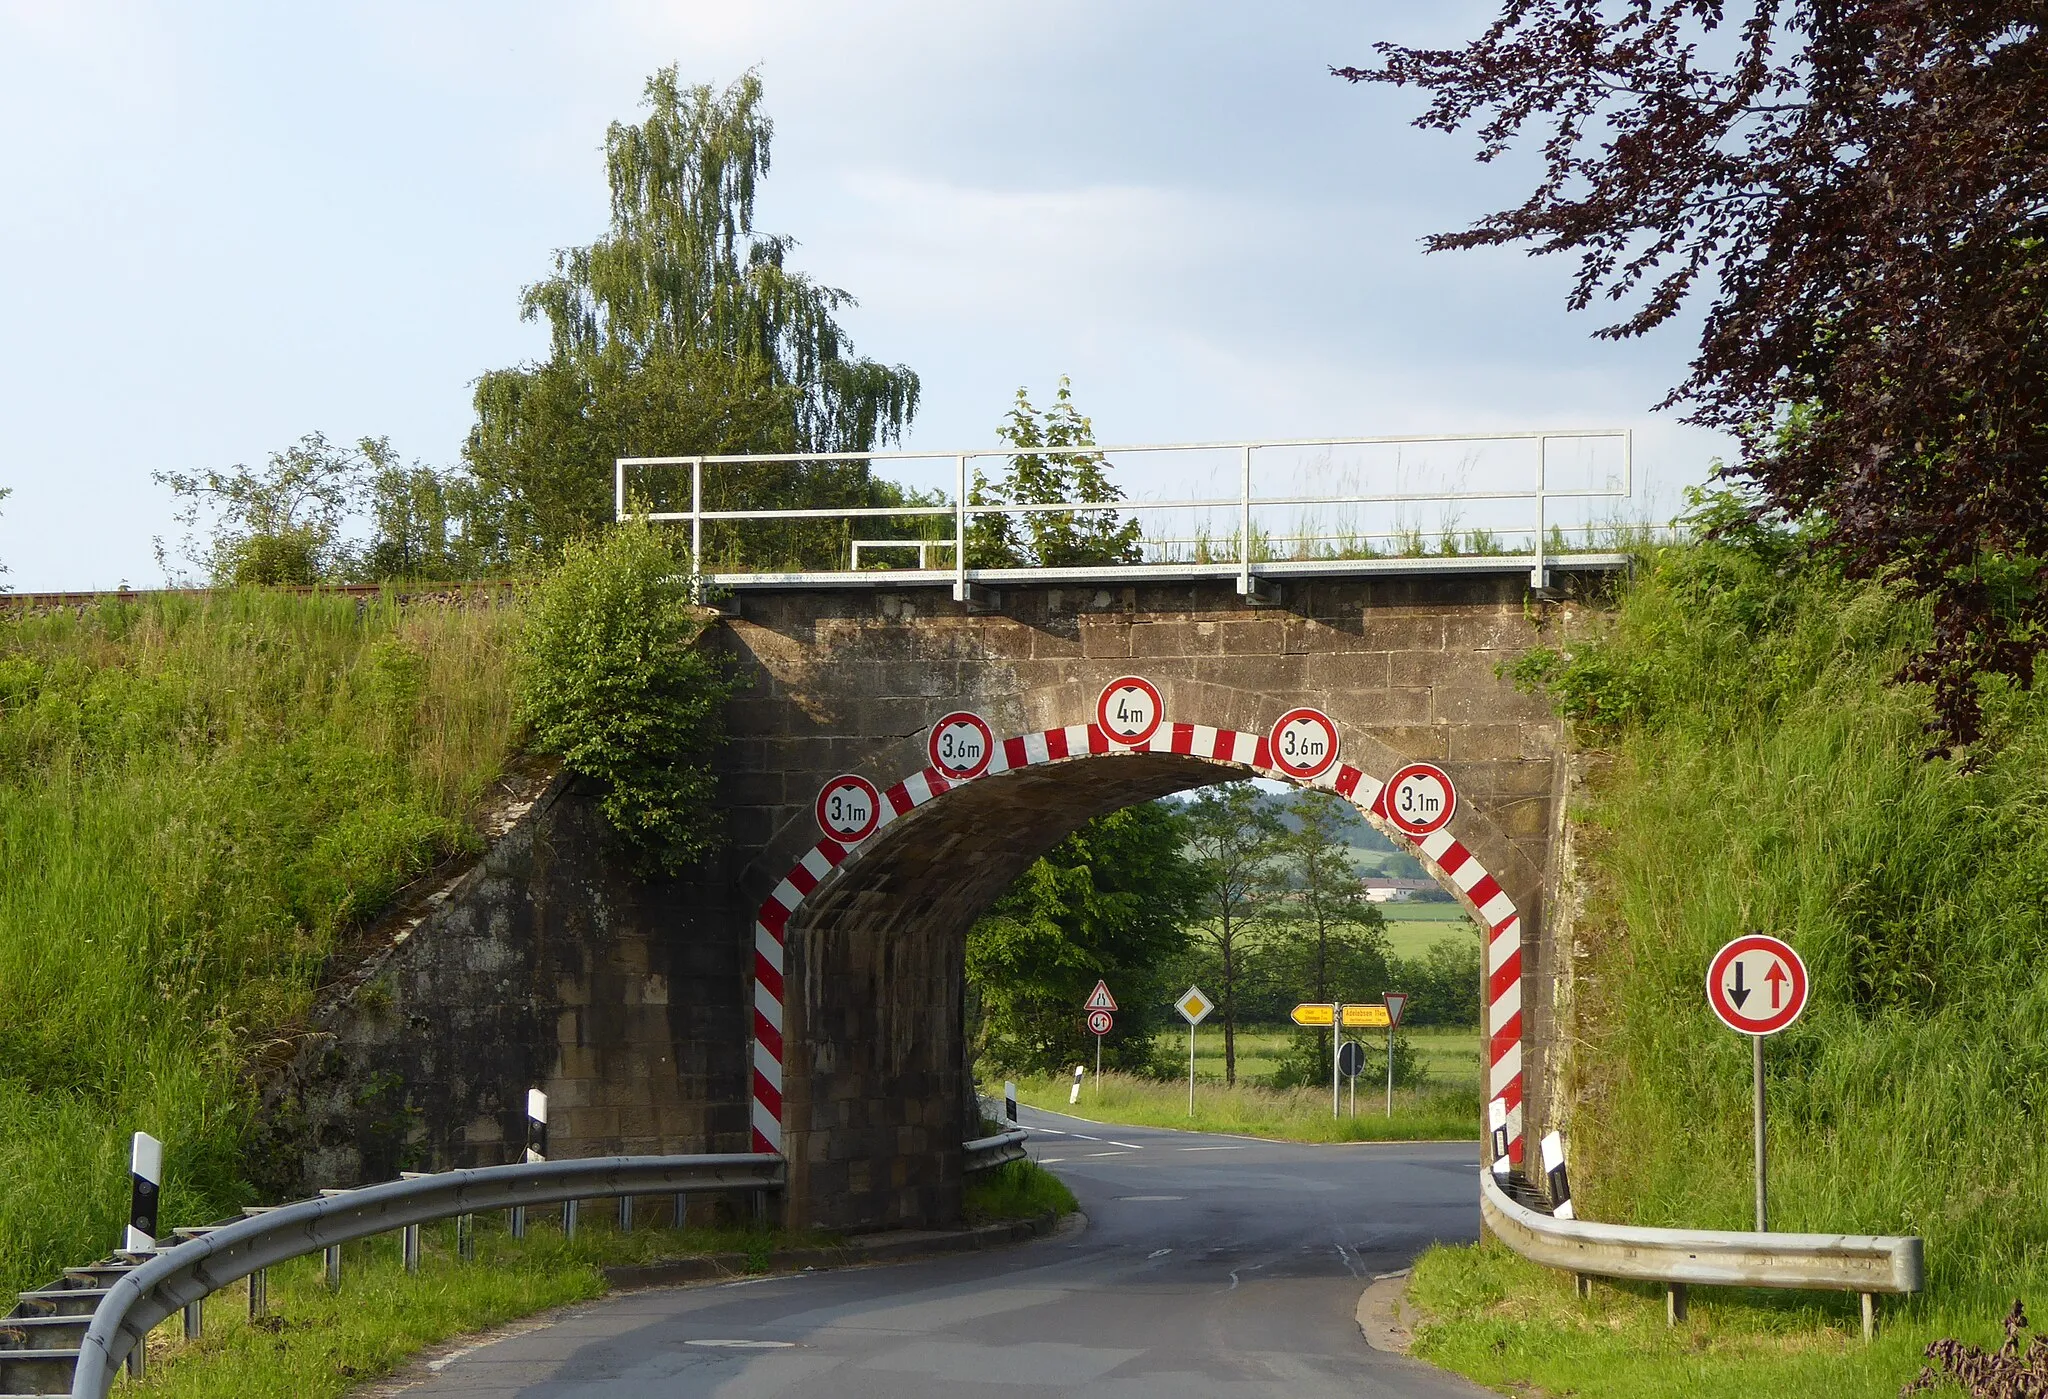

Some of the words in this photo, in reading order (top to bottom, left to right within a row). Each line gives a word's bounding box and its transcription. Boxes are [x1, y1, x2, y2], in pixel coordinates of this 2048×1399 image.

[1117, 698, 1143, 723] 4m
[943, 733, 980, 759] 3,6m
[1285, 730, 1323, 756] 3,6m
[831, 796, 866, 822] 3,1m
[1402, 786, 1439, 812] 3,1m
